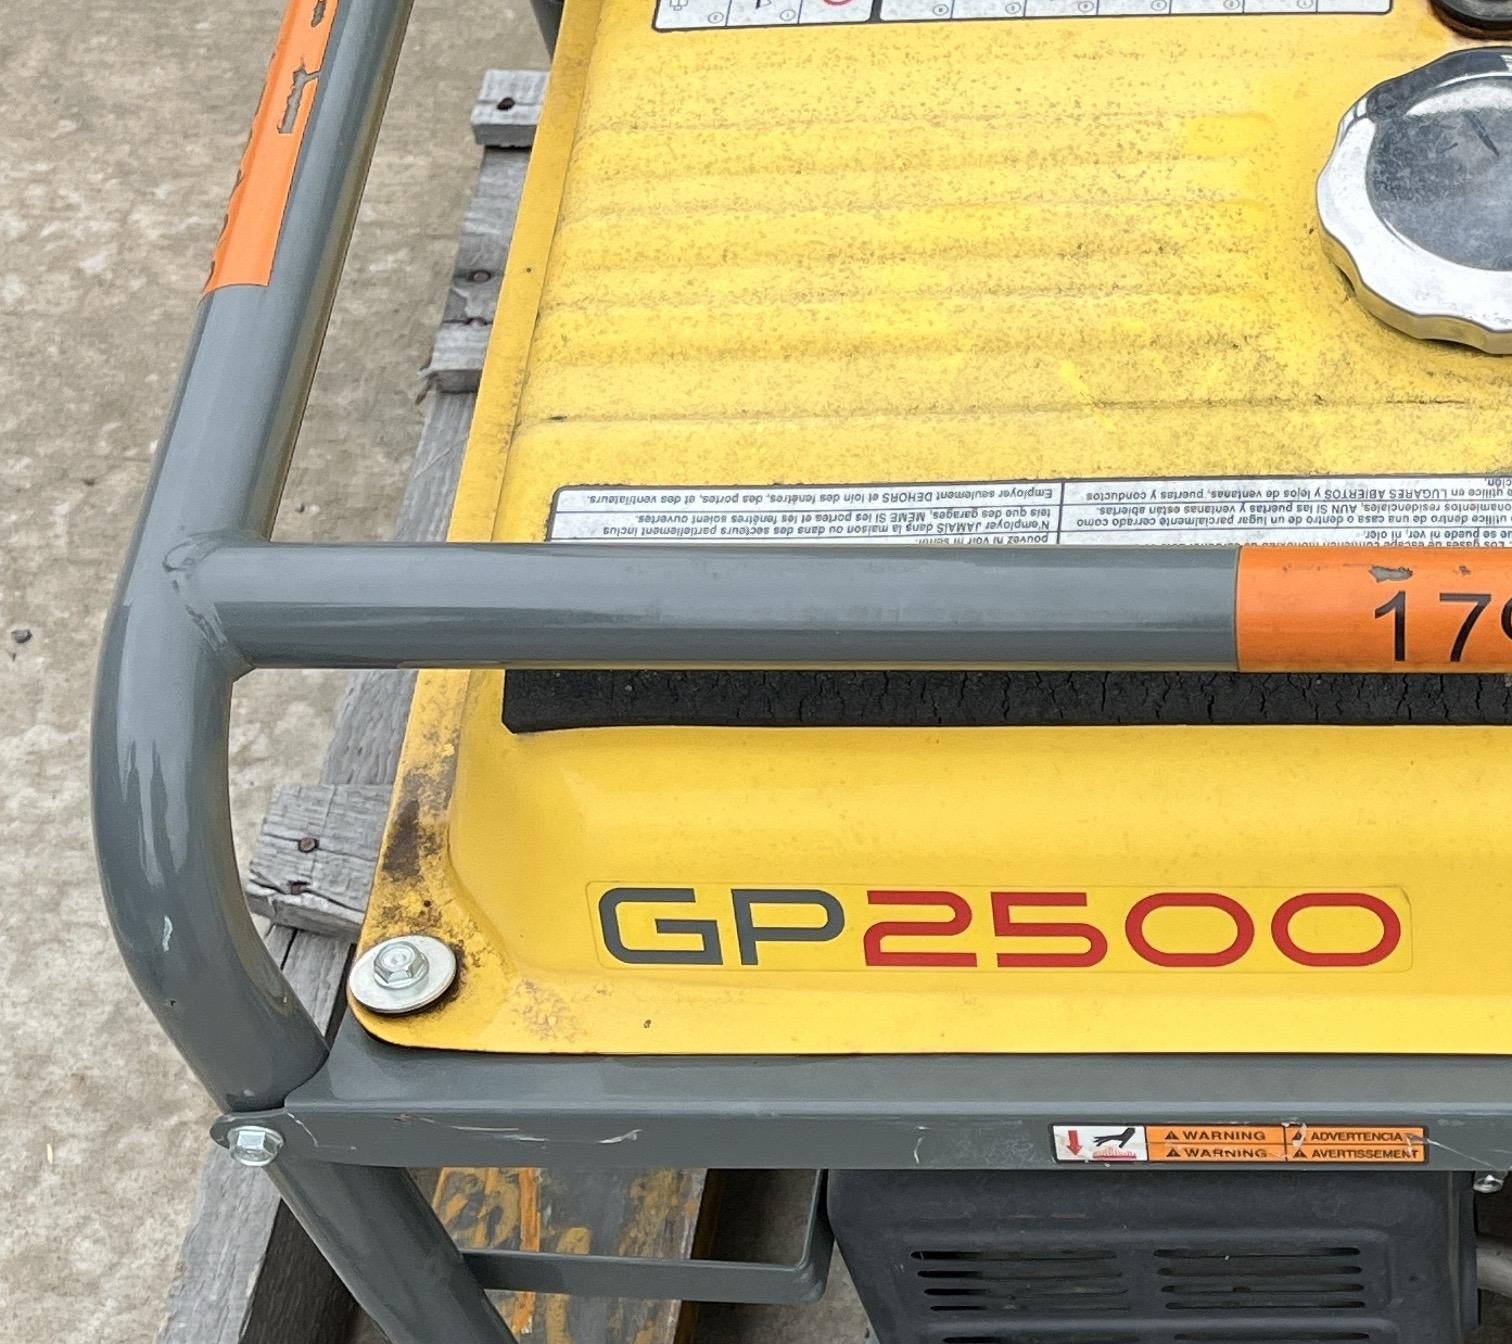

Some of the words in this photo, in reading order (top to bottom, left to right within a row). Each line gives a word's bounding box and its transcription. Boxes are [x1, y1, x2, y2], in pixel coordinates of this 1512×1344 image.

[882, 492, 933, 503] DEHORS
[936, 490, 994, 502] seulement
[998, 487, 1052, 500] Employer
[1076, 519, 1109, 527] como
[1113, 518, 1156, 528] cerrado
[1159, 516, 1234, 527] parcialmente
[1237, 514, 1267, 526] lugar
[1271, 516, 1284, 524] un
[1288, 516, 1302, 526] de
[1306, 515, 1343, 526] dentro
[1347, 515, 1354, 524] o
[1358, 515, 1385, 524] casa
[1388, 515, 1409, 523] una
[1413, 515, 1427, 525] de
[1431, 515, 1468, 525] dentro
[1471, 515, 1507, 525] utilice
[598, 887, 1402, 968] GP2500
[1182, 1131, 1266, 1141] WARNING
[1311, 1131, 1402, 1142] ADVERTENCIA
[1182, 1148, 1268, 1159] WARNING
[1311, 1148, 1420, 1159] AVERTISSEMENT
